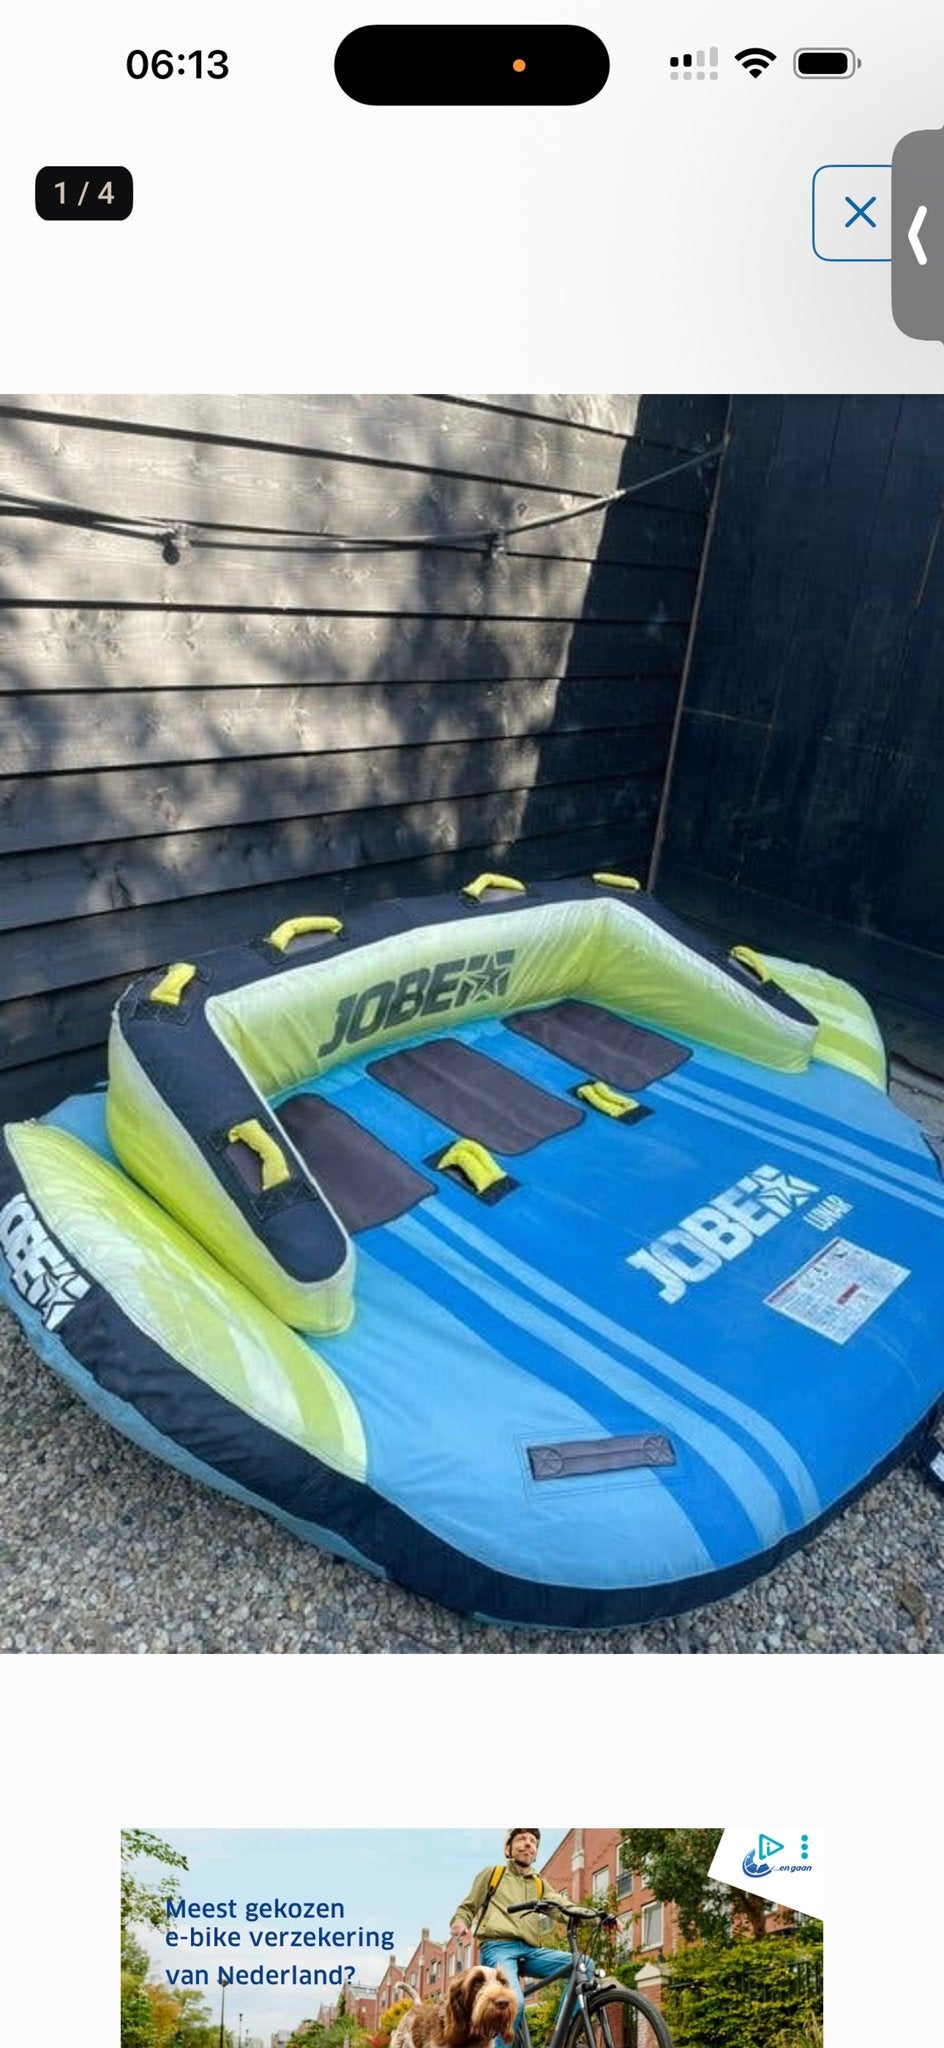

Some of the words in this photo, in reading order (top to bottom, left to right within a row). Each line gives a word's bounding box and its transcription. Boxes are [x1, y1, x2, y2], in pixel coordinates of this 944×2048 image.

[126, 49, 229, 80] 06:13
[54, 181, 66, 205] 1
[97, 181, 115, 205] 4
[317, 958, 467, 1058] JOBE
[802, 1195, 853, 1231] LUNAR
[625, 1176, 781, 1305] JOBE
[166, 1899, 237, 1919] Meest
[245, 1899, 344, 1922] gekozen
[165, 1927, 241, 1947] e-bike
[249, 1927, 394, 1951] verzekering
[166, 1969, 209, 1985] van
[218, 1965, 356, 1986] Nederland?
